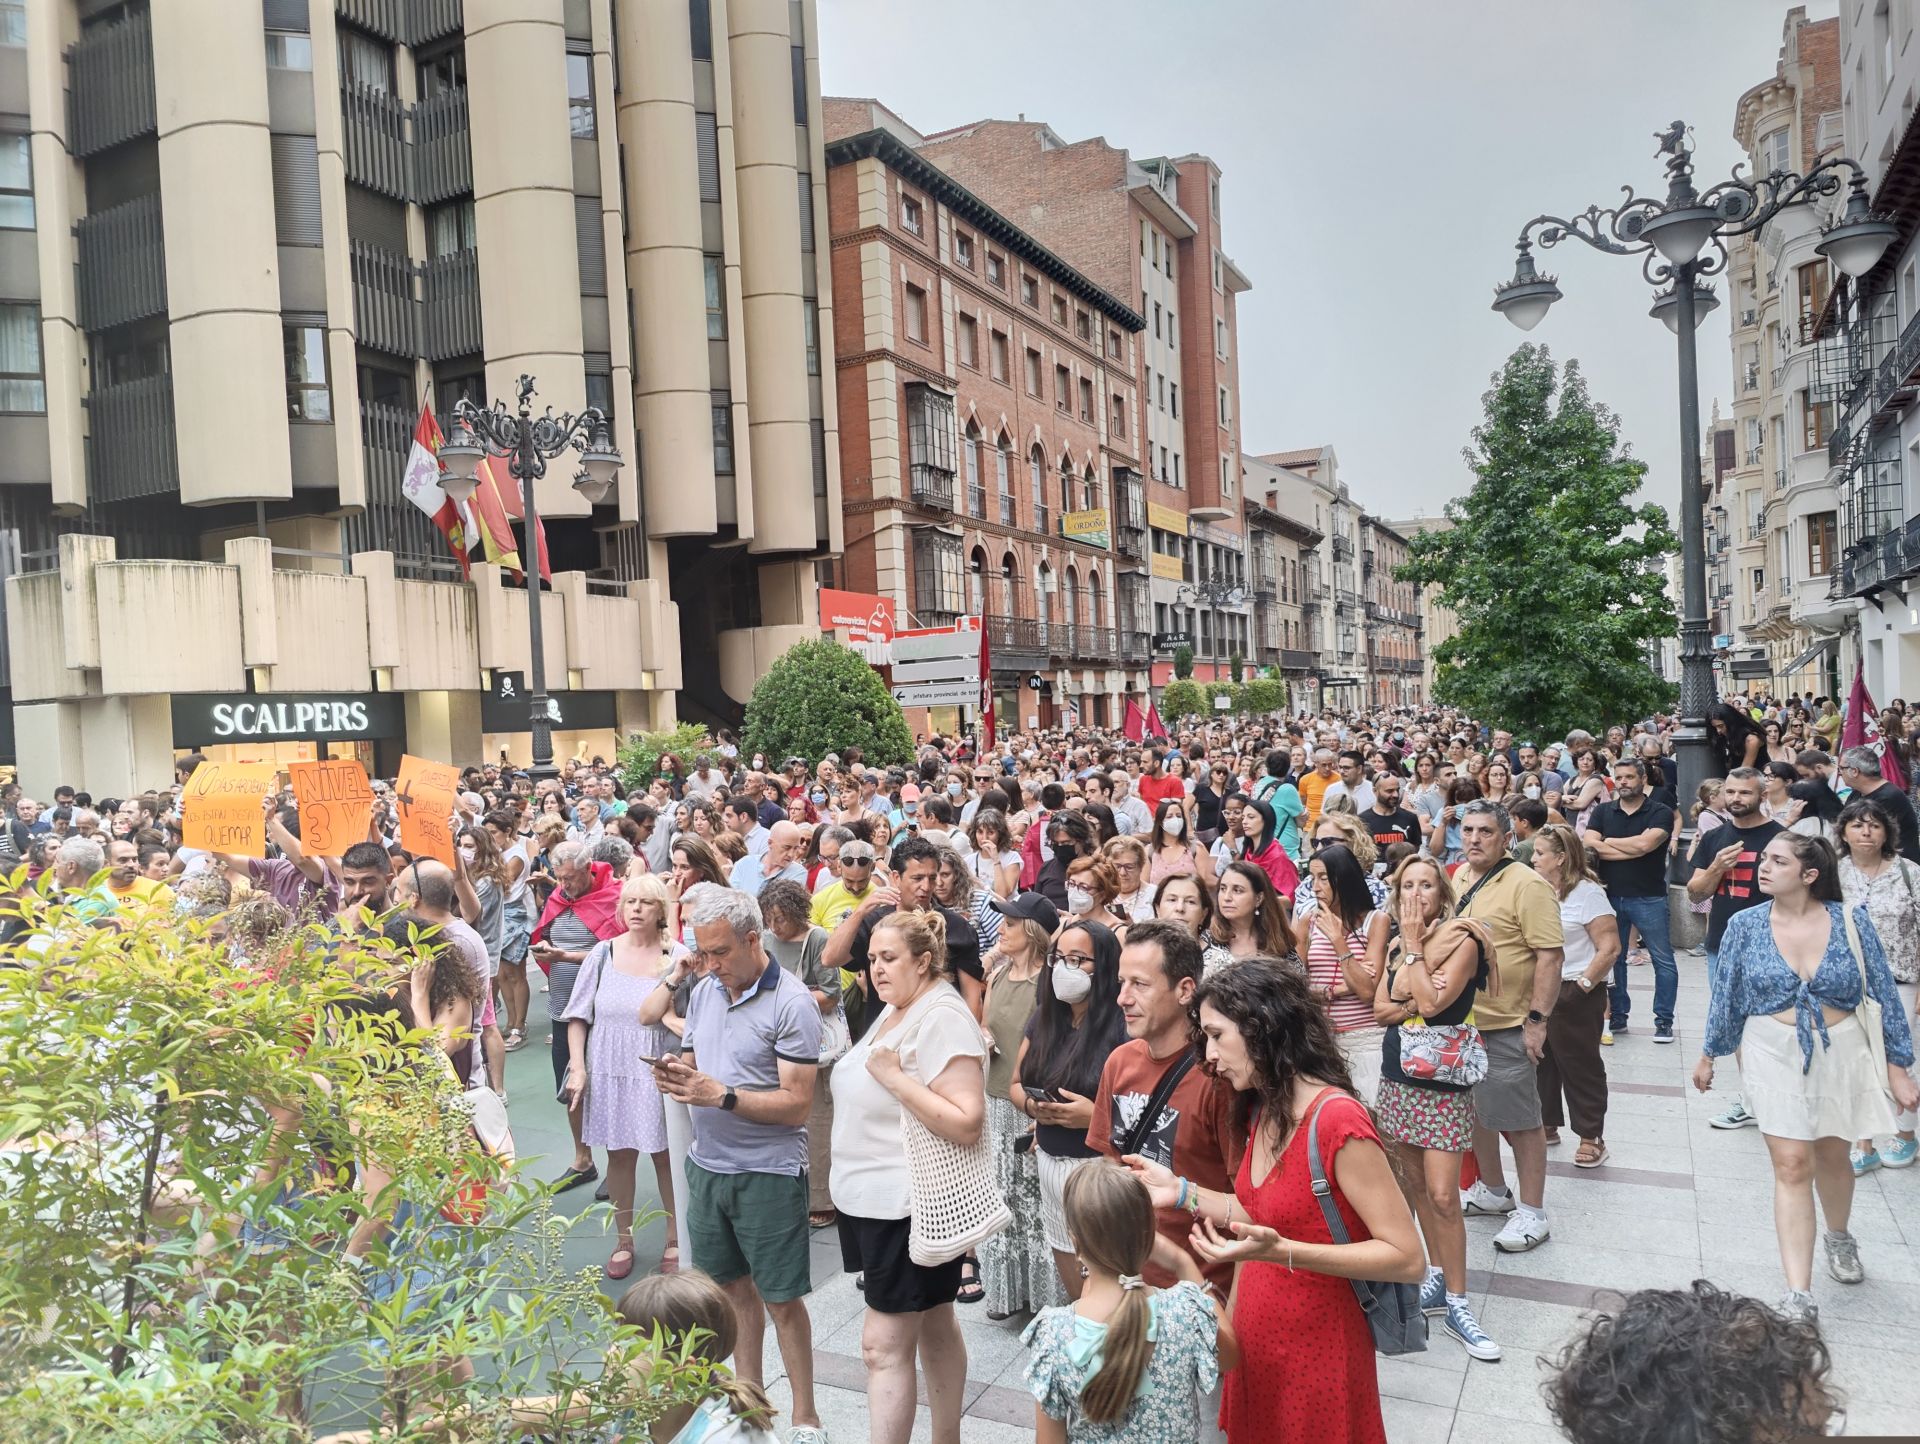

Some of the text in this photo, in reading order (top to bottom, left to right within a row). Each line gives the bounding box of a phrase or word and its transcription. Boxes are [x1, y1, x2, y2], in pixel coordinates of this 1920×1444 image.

[1073, 518, 1106, 529] ORDOÑO
[1030, 678, 1041, 688] IN
[934, 691, 958, 699] provincial
[212, 701, 369, 736] SCALPERS
[193, 766, 220, 796] 10
[306, 803, 333, 850] 3
[203, 825, 253, 848] QUEMAR
[1374, 833, 1404, 844] PUMA
